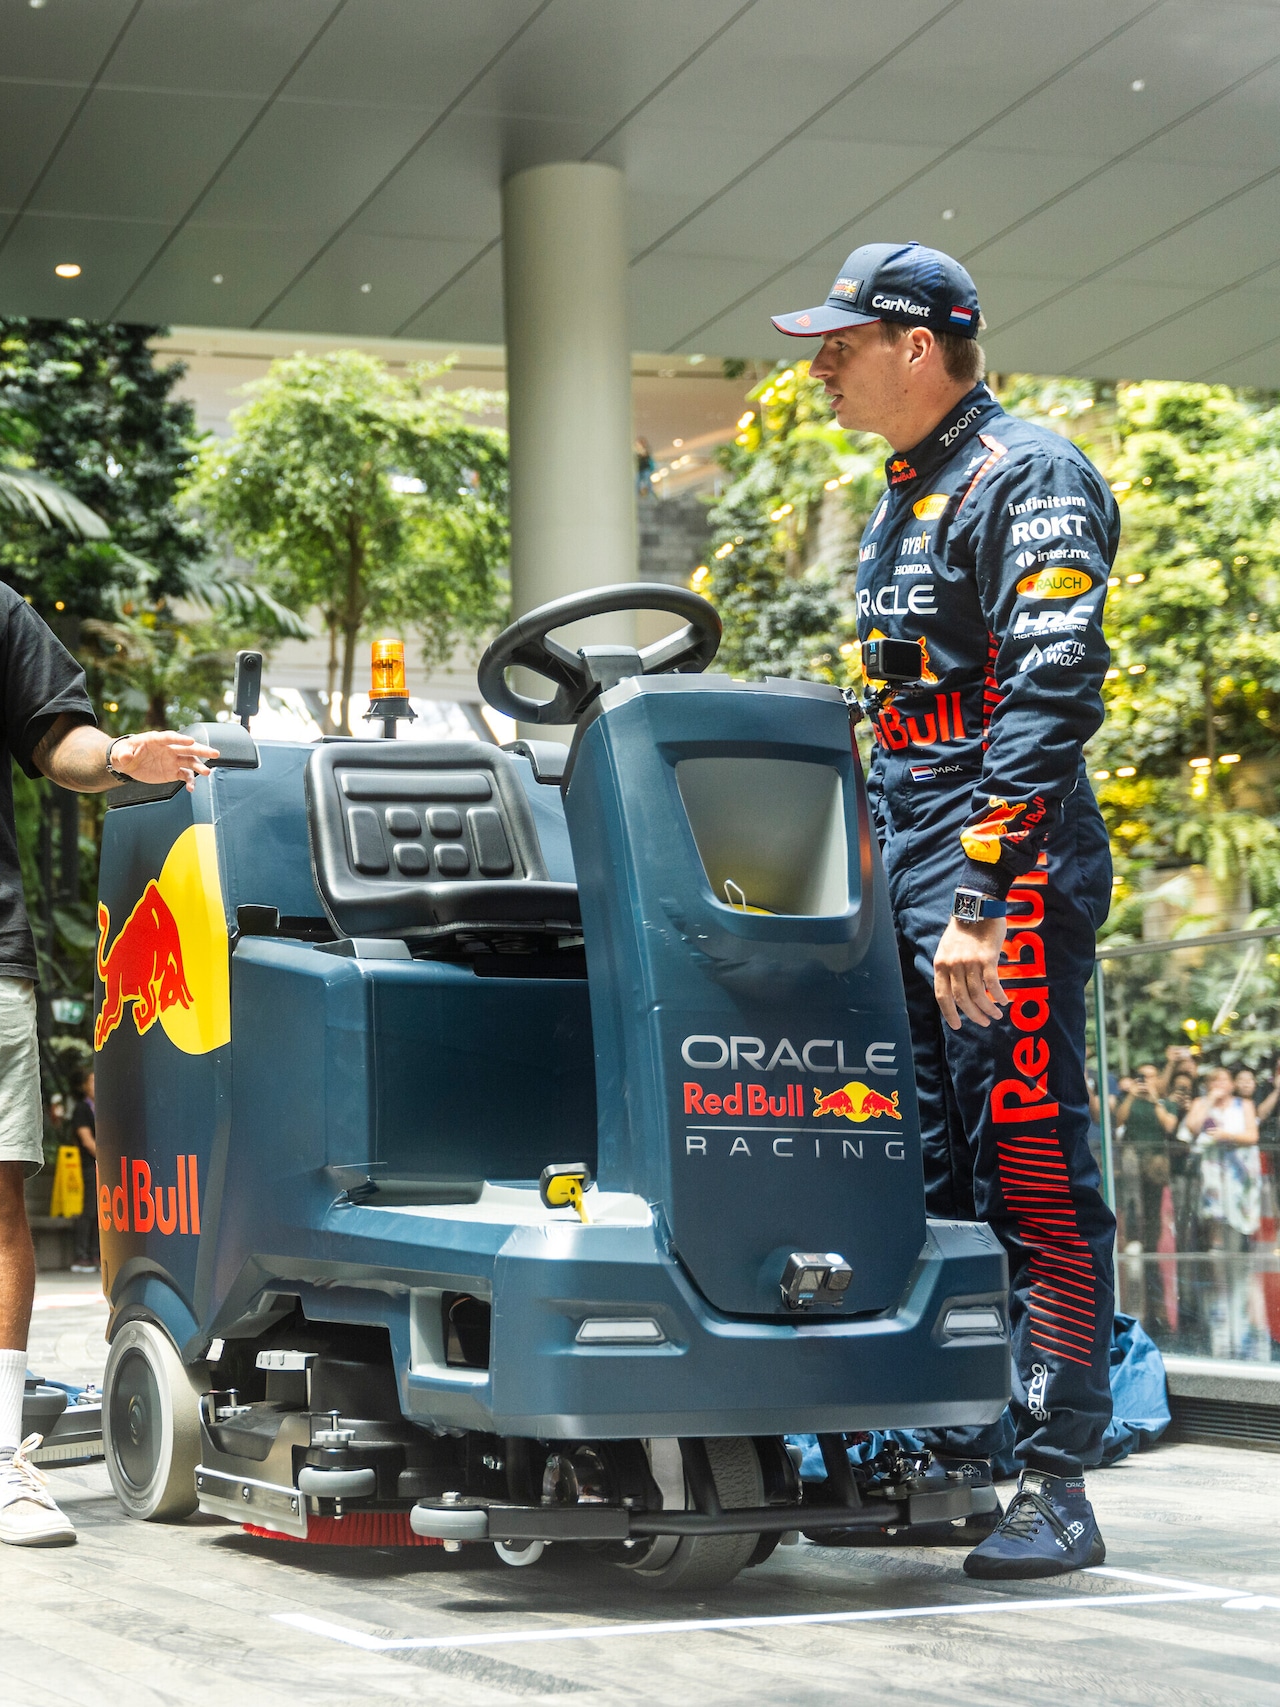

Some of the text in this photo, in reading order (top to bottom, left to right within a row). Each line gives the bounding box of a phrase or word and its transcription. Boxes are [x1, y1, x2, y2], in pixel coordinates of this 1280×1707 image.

[871, 294, 931, 318] CarNext
[939, 406, 982, 447] zoom
[1007, 495, 1086, 517] infinitum
[1010, 514, 1087, 547] ROKT
[893, 563, 933, 576] HONDA
[1037, 549, 1091, 564] inter.mx
[1036, 576, 1082, 592] RAUCH
[856, 584, 939, 621] RACLE
[1012, 624, 1088, 641] Honda RACING
[1043, 638, 1087, 667] ARCTIC WOLF
[877, 690, 967, 751] Bull
[933, 764, 963, 776] MAX
[1025, 795, 1047, 823] Bull
[986, 852, 1060, 1124] Red Bul
[680, 1034, 899, 1076] ORACLE
[683, 1082, 805, 1117] Red Bull
[685, 1135, 906, 1161] RACING
[95, 1156, 130, 1233] ed
[131, 1154, 201, 1236] Bull
